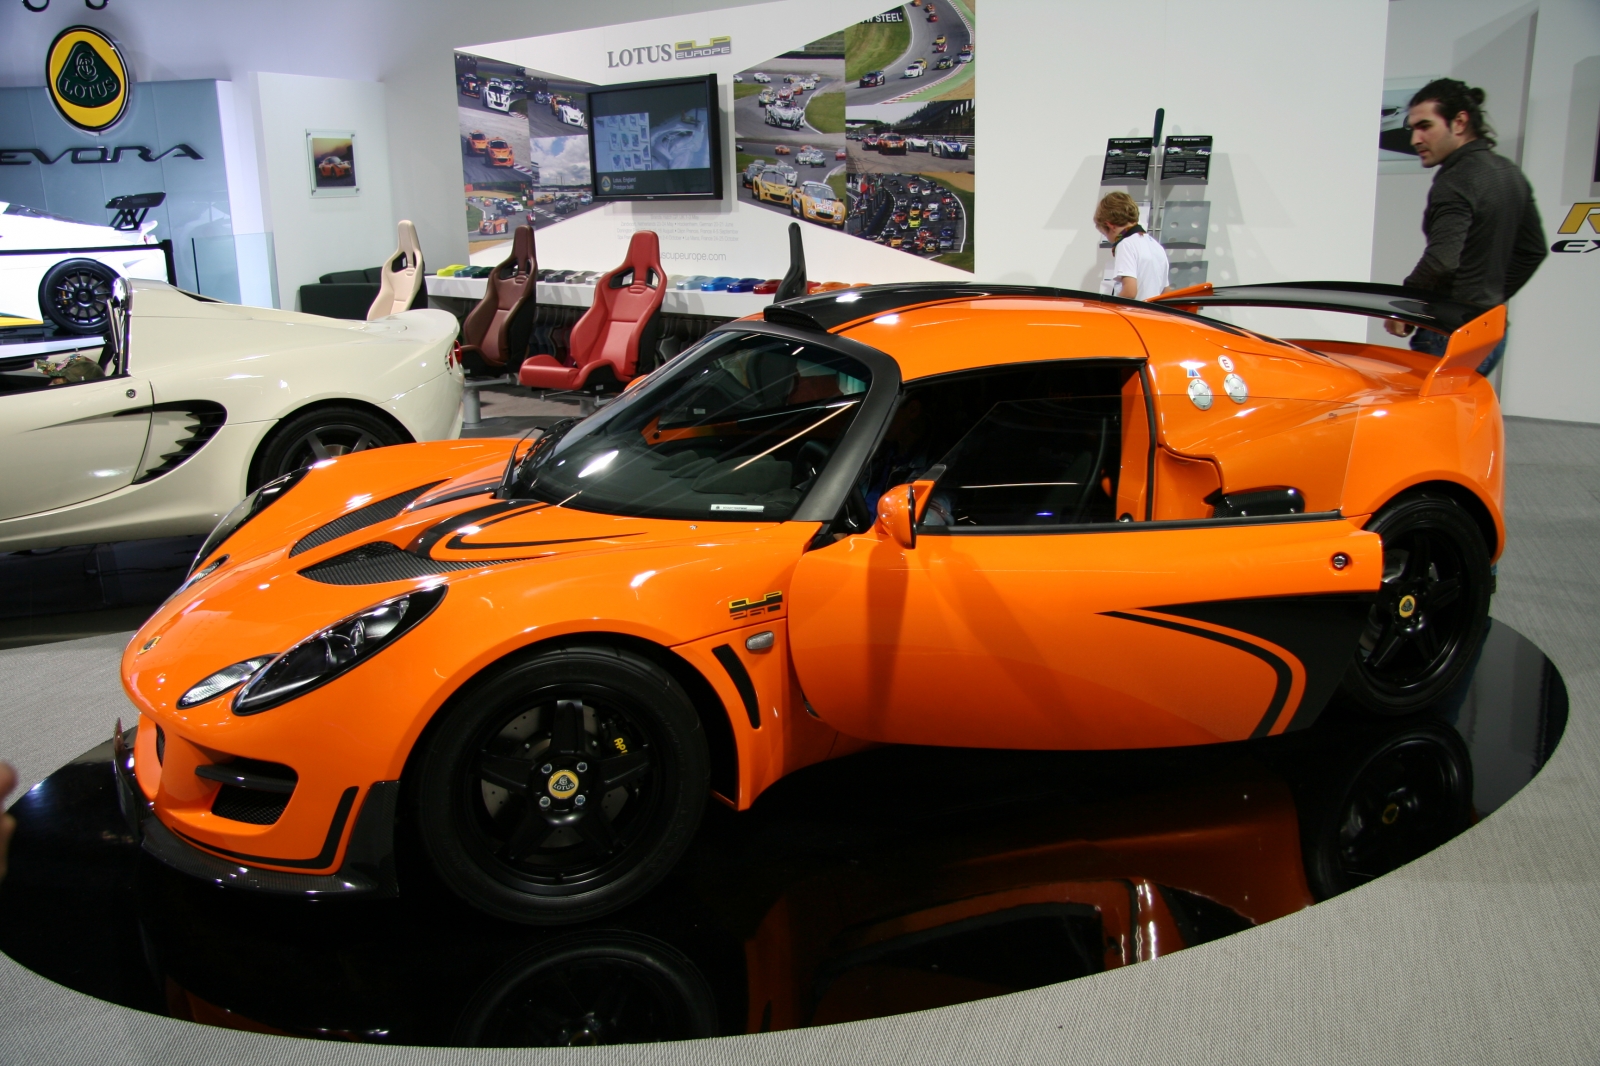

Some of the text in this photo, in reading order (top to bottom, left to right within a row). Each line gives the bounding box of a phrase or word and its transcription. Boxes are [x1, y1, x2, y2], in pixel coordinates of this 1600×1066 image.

[875, 13, 903, 23] STEEL
[606, 35, 731, 68] LOTUS CUP
[676, 46, 730, 59] EUROPE
[63, 76, 117, 99] LOTUS
[0, 143, 205, 166] EVORA
[553, 782, 575, 791] LOTUS
